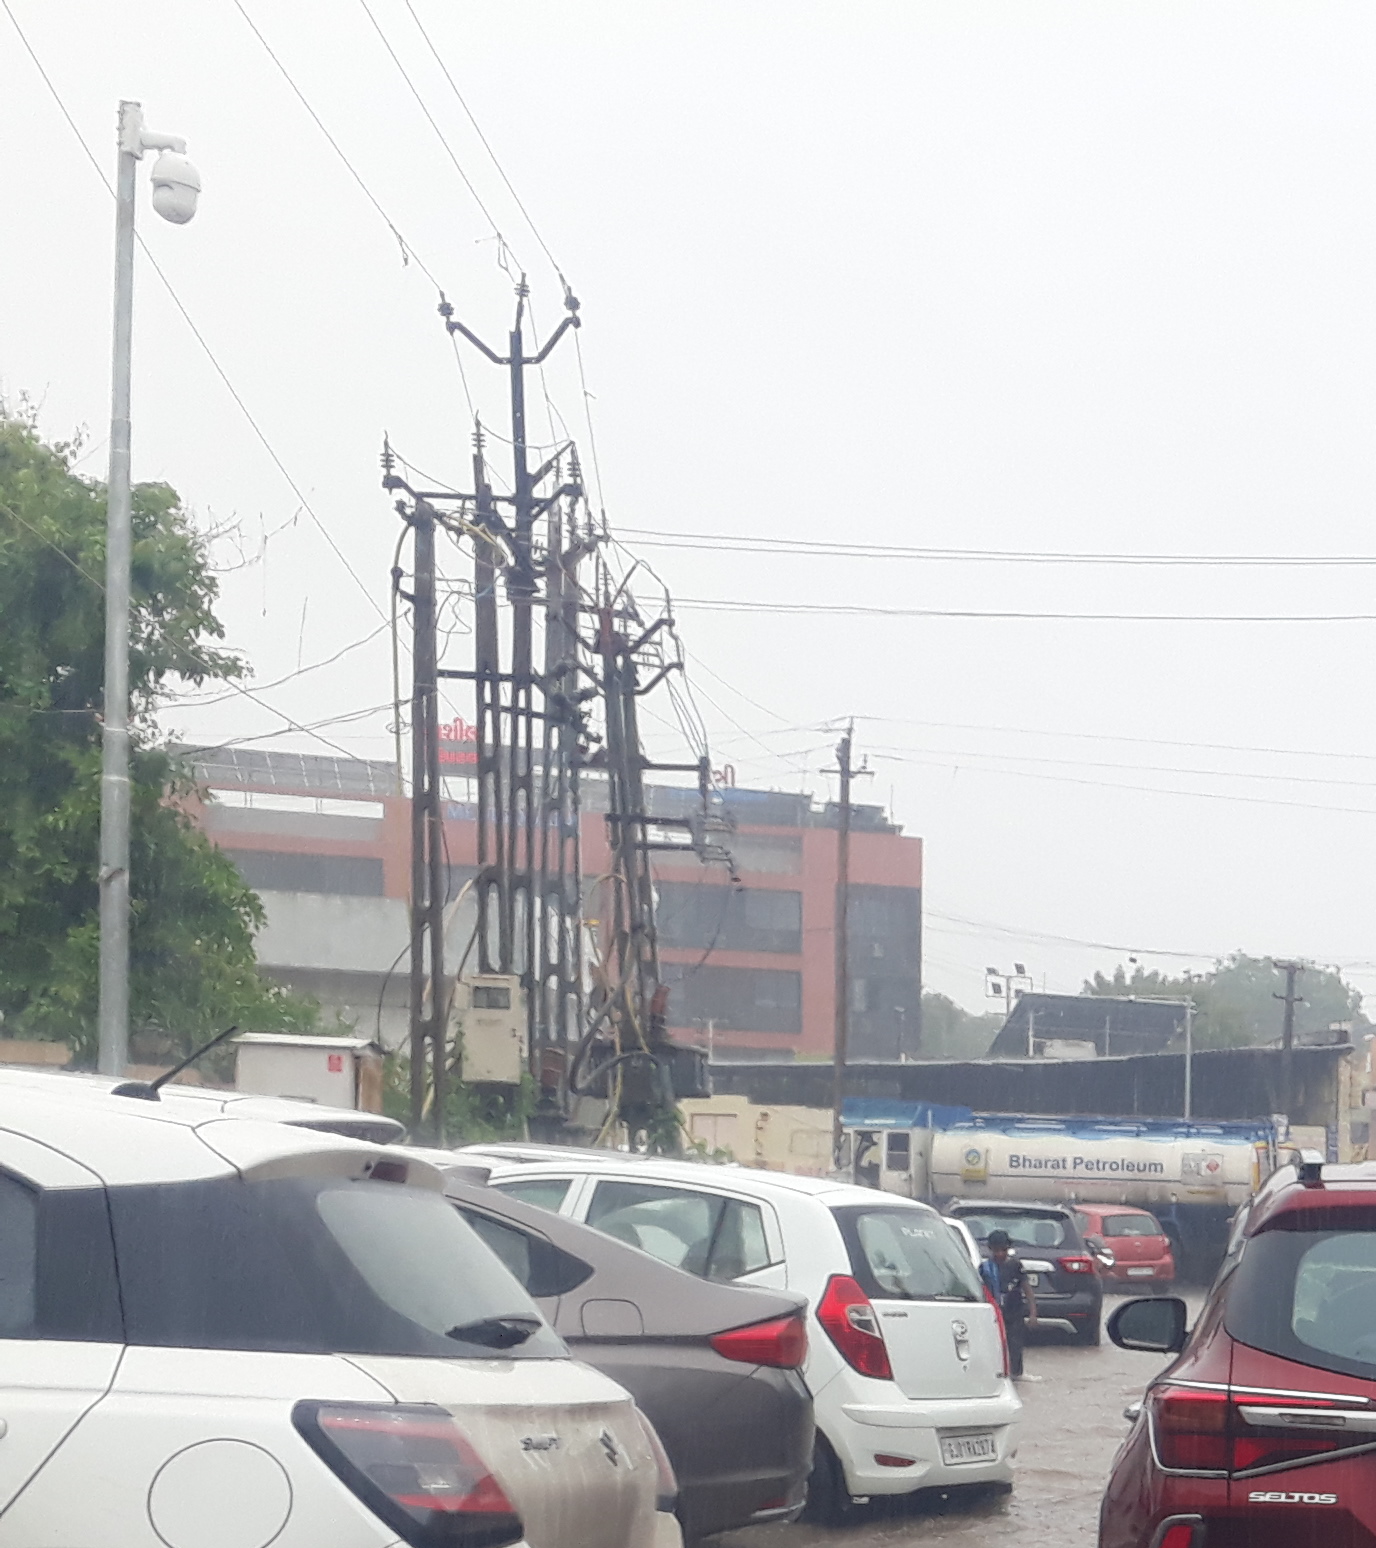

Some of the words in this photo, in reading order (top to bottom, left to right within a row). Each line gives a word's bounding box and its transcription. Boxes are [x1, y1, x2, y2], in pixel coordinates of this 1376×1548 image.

[1008, 1154, 1068, 1171] Bharat
[1072, 1156, 1164, 1175] Petroleum
[1248, 1490, 1338, 1505] SELTOS
